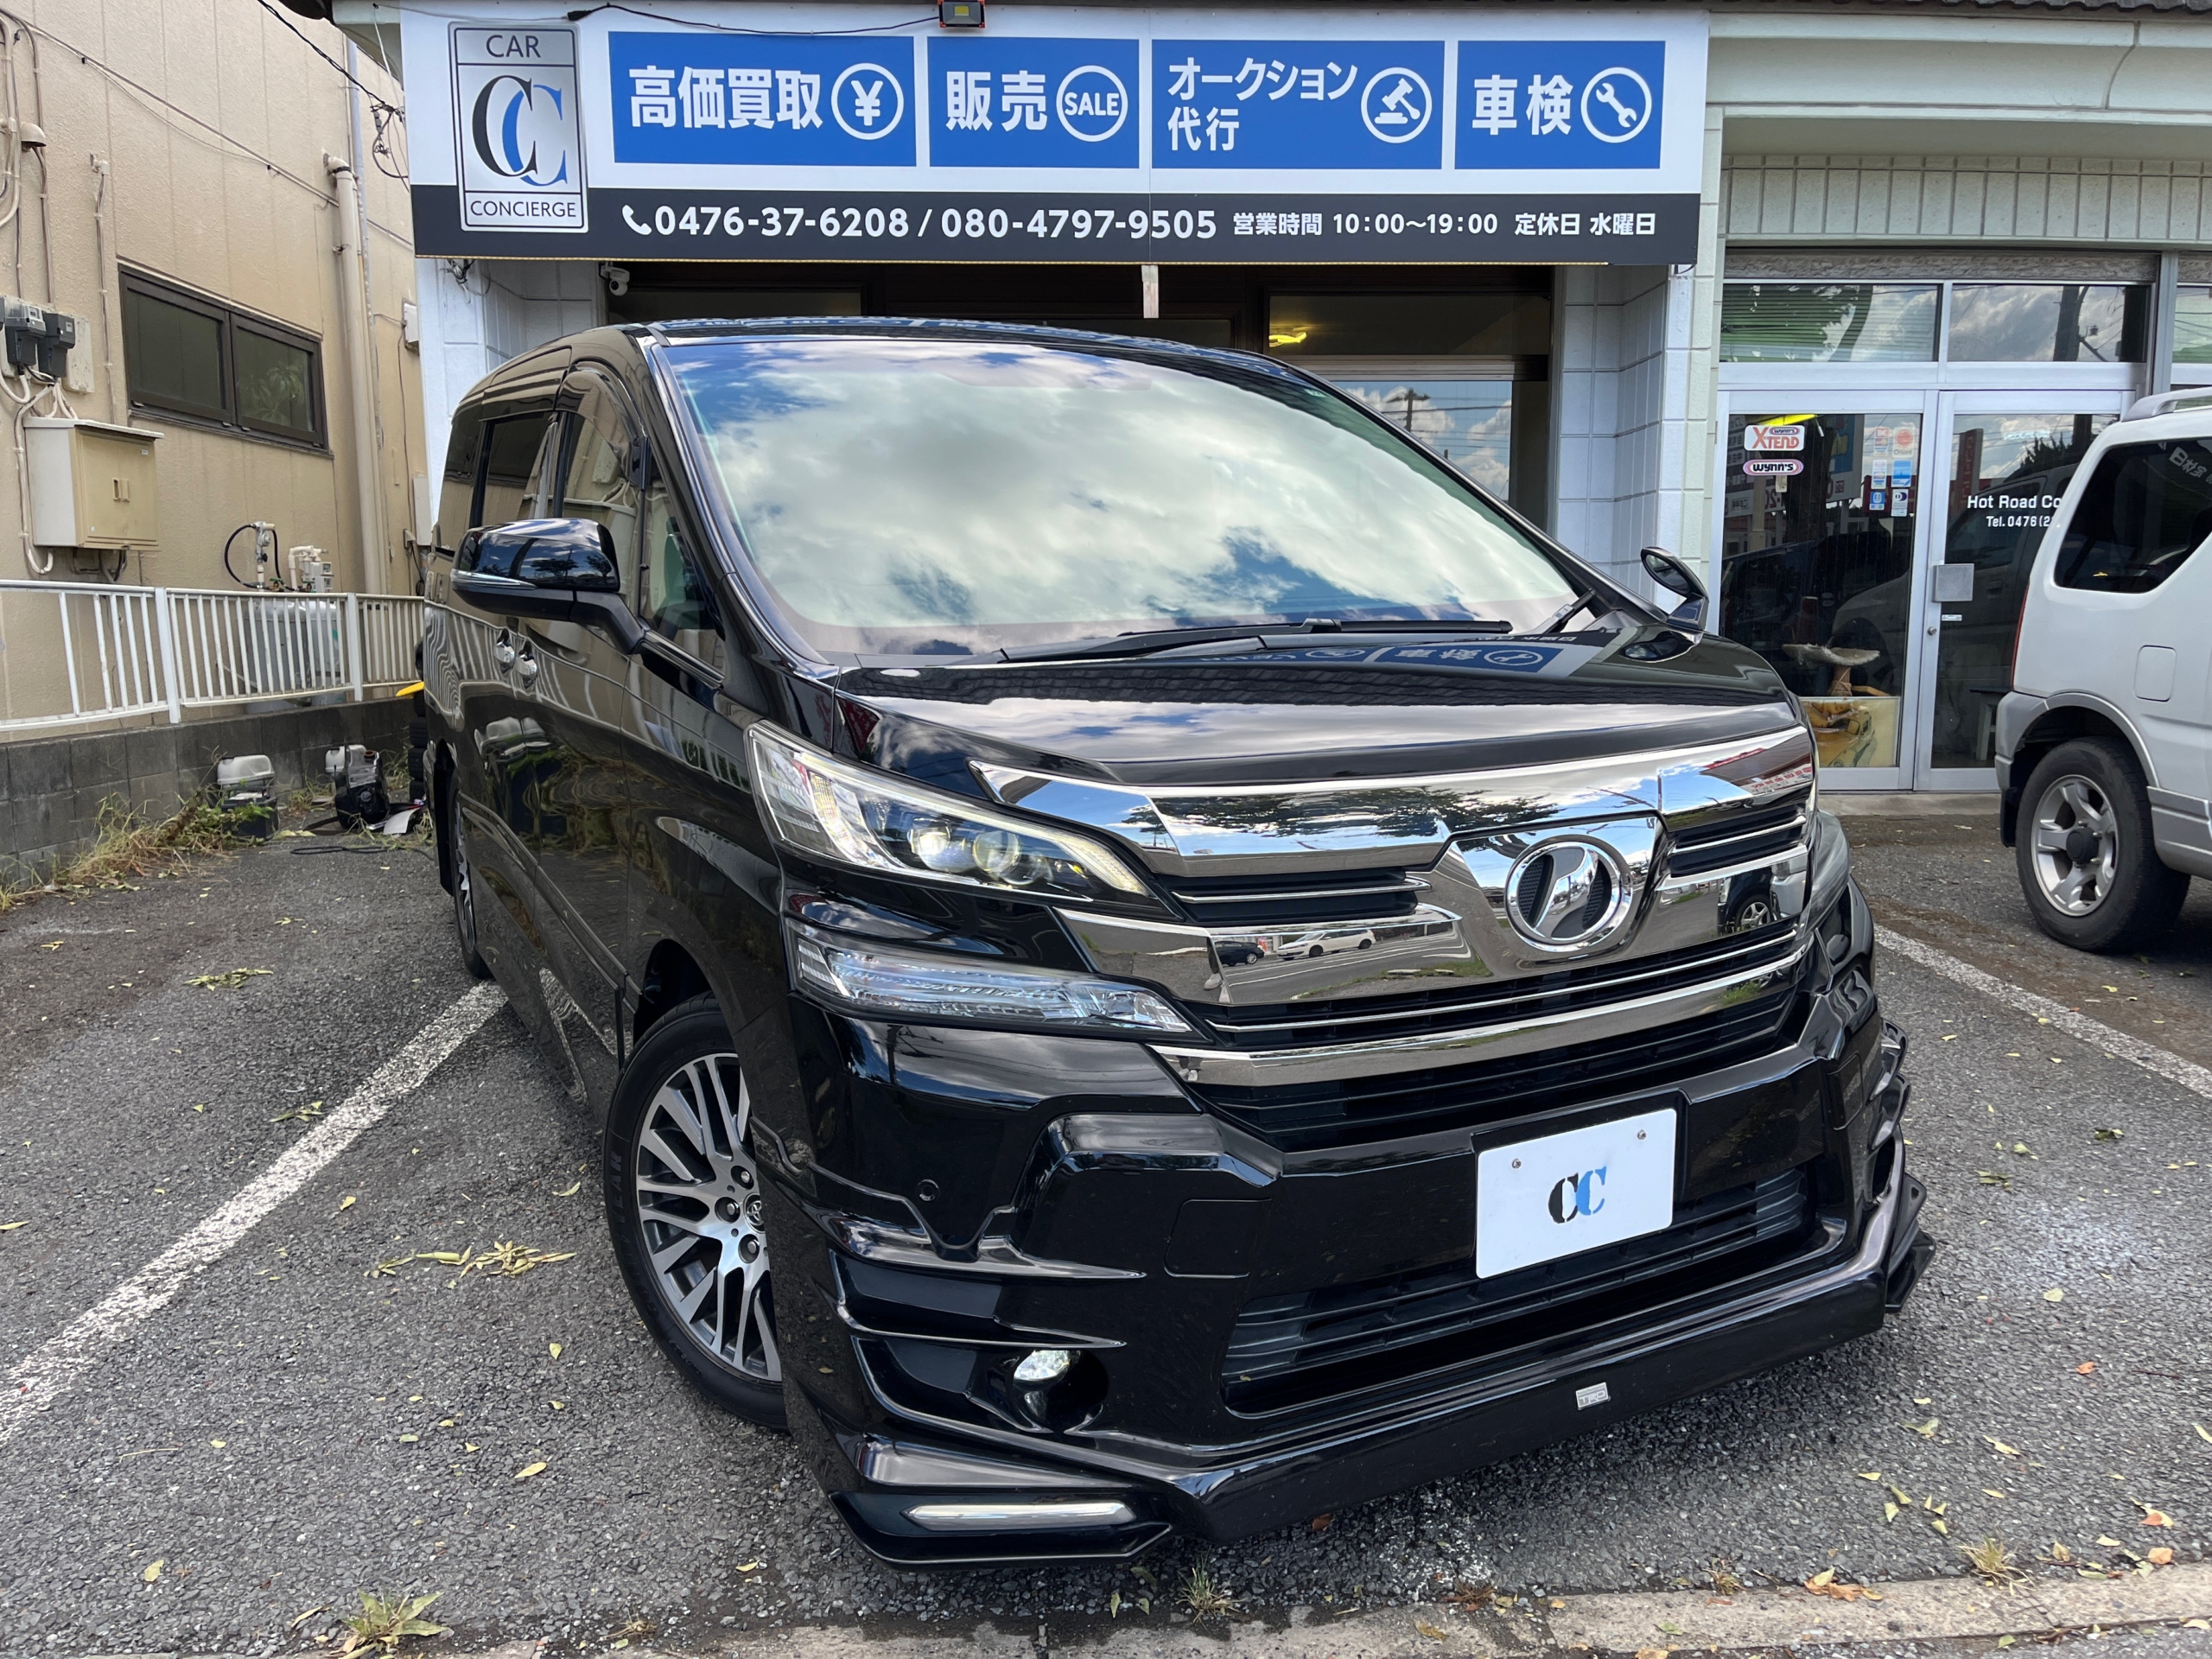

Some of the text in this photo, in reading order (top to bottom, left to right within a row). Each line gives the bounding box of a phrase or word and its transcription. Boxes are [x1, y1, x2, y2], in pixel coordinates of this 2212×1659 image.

[485, 35, 542, 60] CAR
[628, 65, 823, 131] 高価買取
[1167, 56, 1358, 102] オークション
[945, 69, 1048, 132] 販売
[1063, 92, 1120, 117] SALE
[1471, 74, 1573, 136] 車検
[1167, 106, 1240, 152] 代行
[470, 200, 577, 219] CONCIERGE
[654, 205, 910, 238] 0476-37-6208
[941, 208, 1217, 238] 080-4797-9505
[1233, 213, 1323, 236] 営業時間
[1514, 213, 1580, 236] 定休日
[1589, 213, 1656, 236] 水曜日
[1967, 495, 1994, 508] Hot
[1999, 495, 2037, 508] Road
[1548, 1166, 1607, 1224] CC
